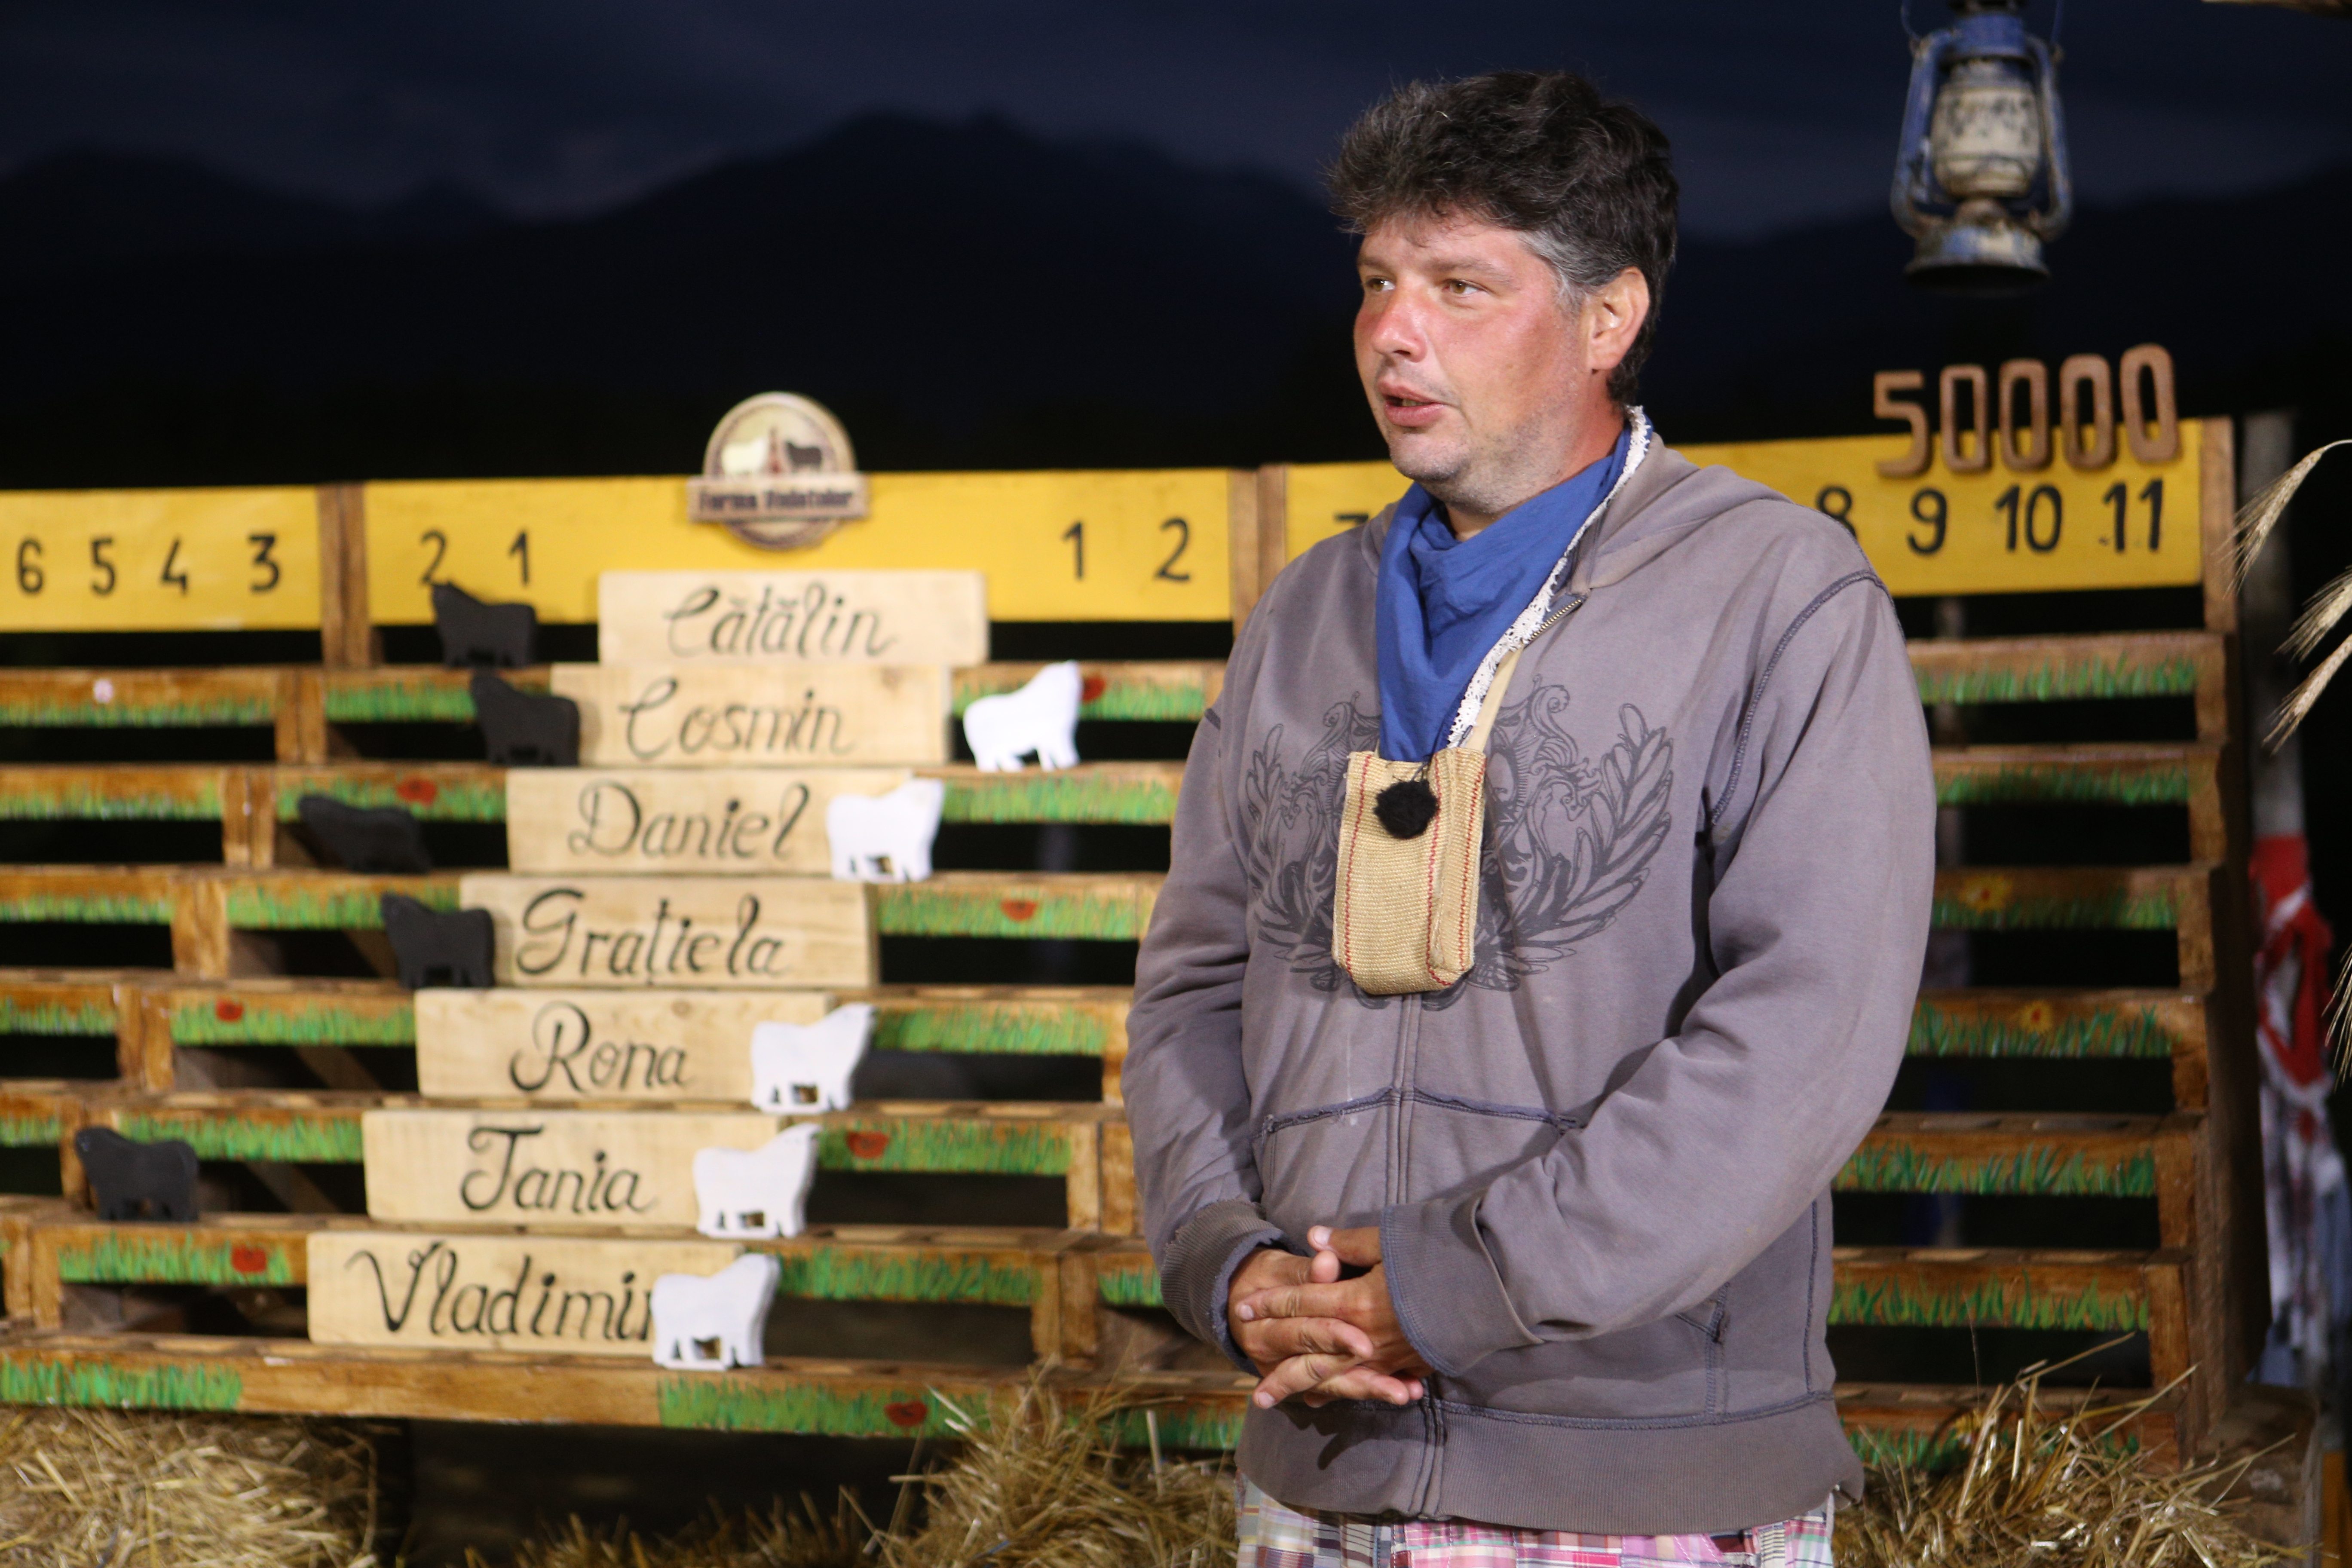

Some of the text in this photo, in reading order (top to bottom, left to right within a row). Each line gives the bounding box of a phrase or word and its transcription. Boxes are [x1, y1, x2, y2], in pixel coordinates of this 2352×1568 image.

[1873, 344, 2178, 479] 50000
[1062, 516, 1191, 582] 1 2
[1906, 486, 1948, 555] 9
[1994, 481, 2063, 554] 10
[2102, 477, 2163, 554] 11
[16, 533, 281, 597] 6 5 4 3
[420, 529, 530, 586] 2 1
[663, 579, 898, 658] Cătălin
[619, 677, 858, 760] Cosmin
[568, 779, 810, 859] Daniel
[508, 1000, 693, 1093] Rona
[459, 1123, 658, 1213] Tania
